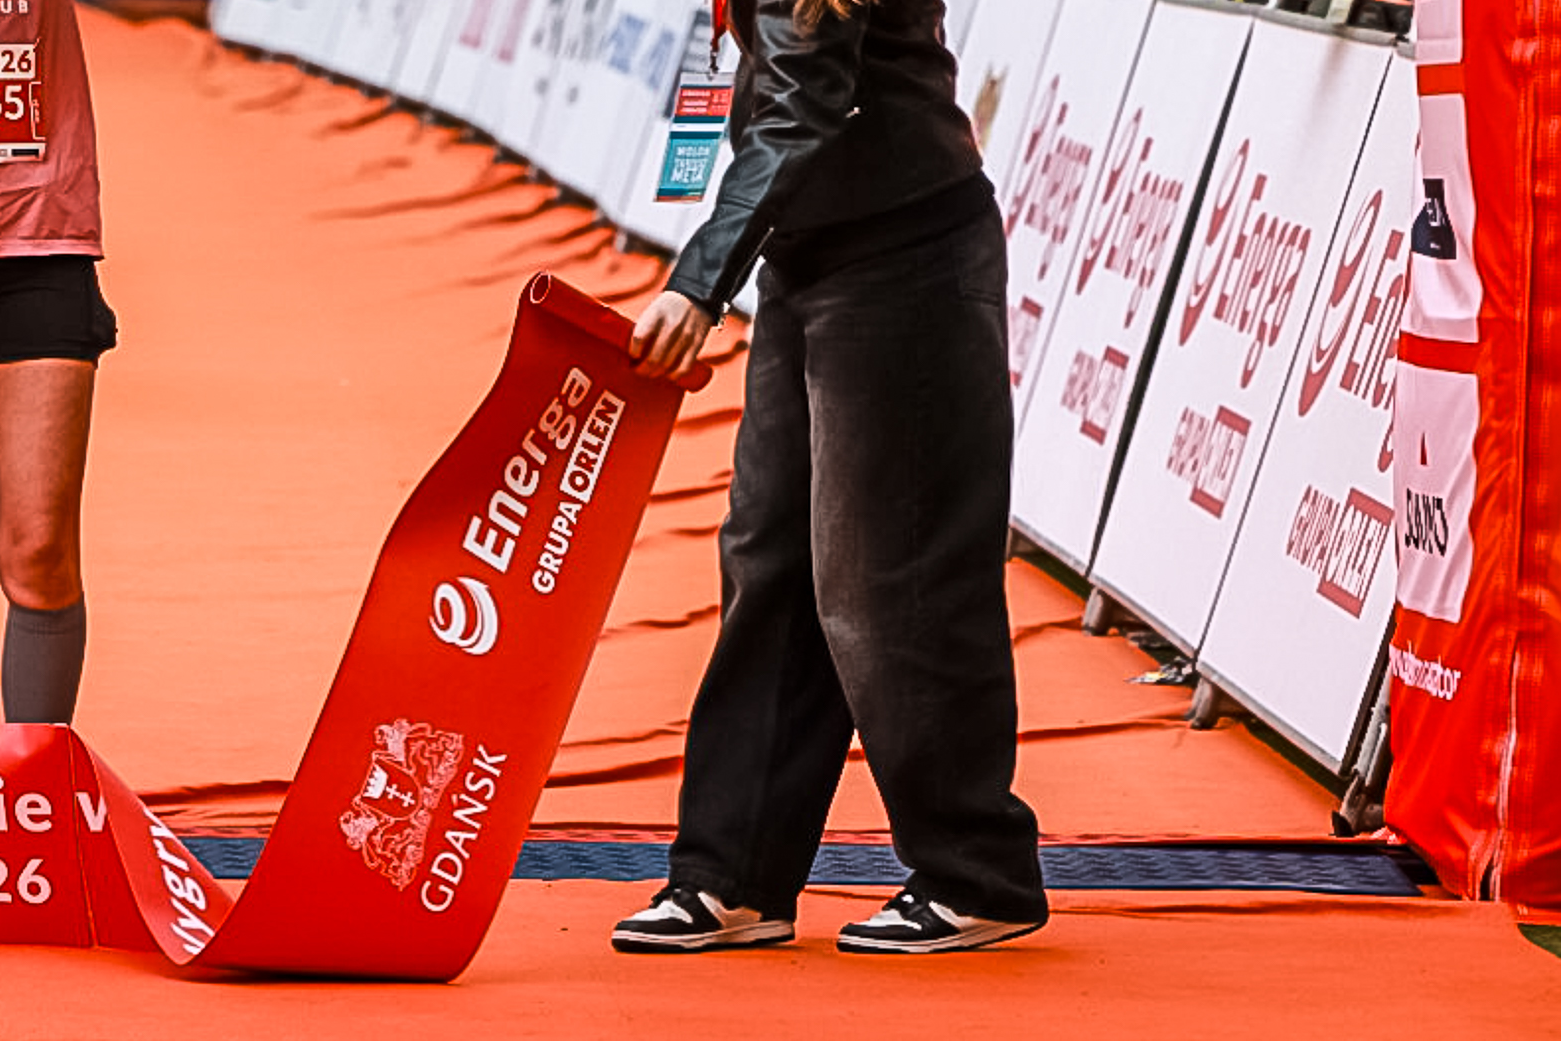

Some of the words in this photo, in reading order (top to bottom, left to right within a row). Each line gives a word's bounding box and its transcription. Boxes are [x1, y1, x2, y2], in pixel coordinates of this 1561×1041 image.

[1213, 173, 1312, 389] Energa
[461, 366, 593, 575] Energa
[531, 500, 583, 595] GRUPA
[564, 394, 622, 498] ORLEN
[419, 743, 509, 914] GDAŃSK
